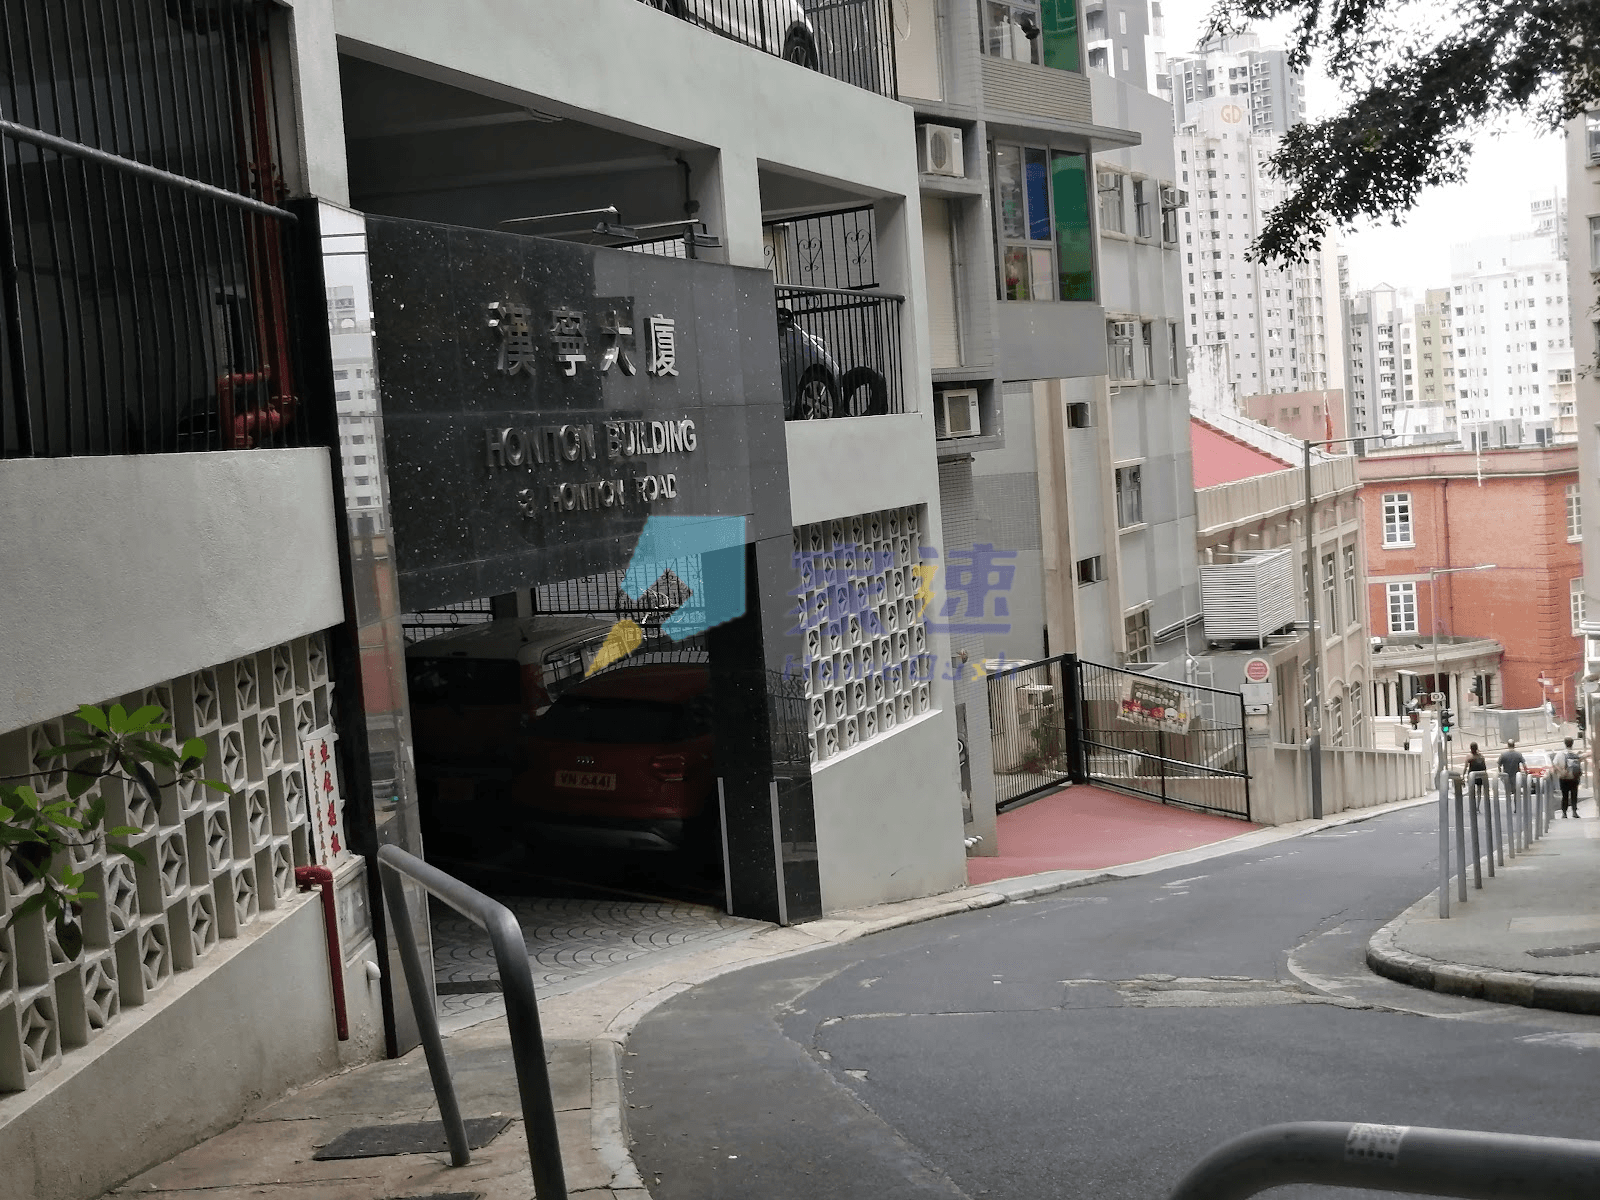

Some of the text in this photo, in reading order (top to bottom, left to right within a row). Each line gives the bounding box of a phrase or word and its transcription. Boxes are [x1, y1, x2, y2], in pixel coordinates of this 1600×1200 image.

[1220, 104, 1242, 124] GD
[487, 301, 680, 378] 漢寧大廈
[603, 420, 697, 459] BUILDING
[634, 473, 677, 504] ROAD
